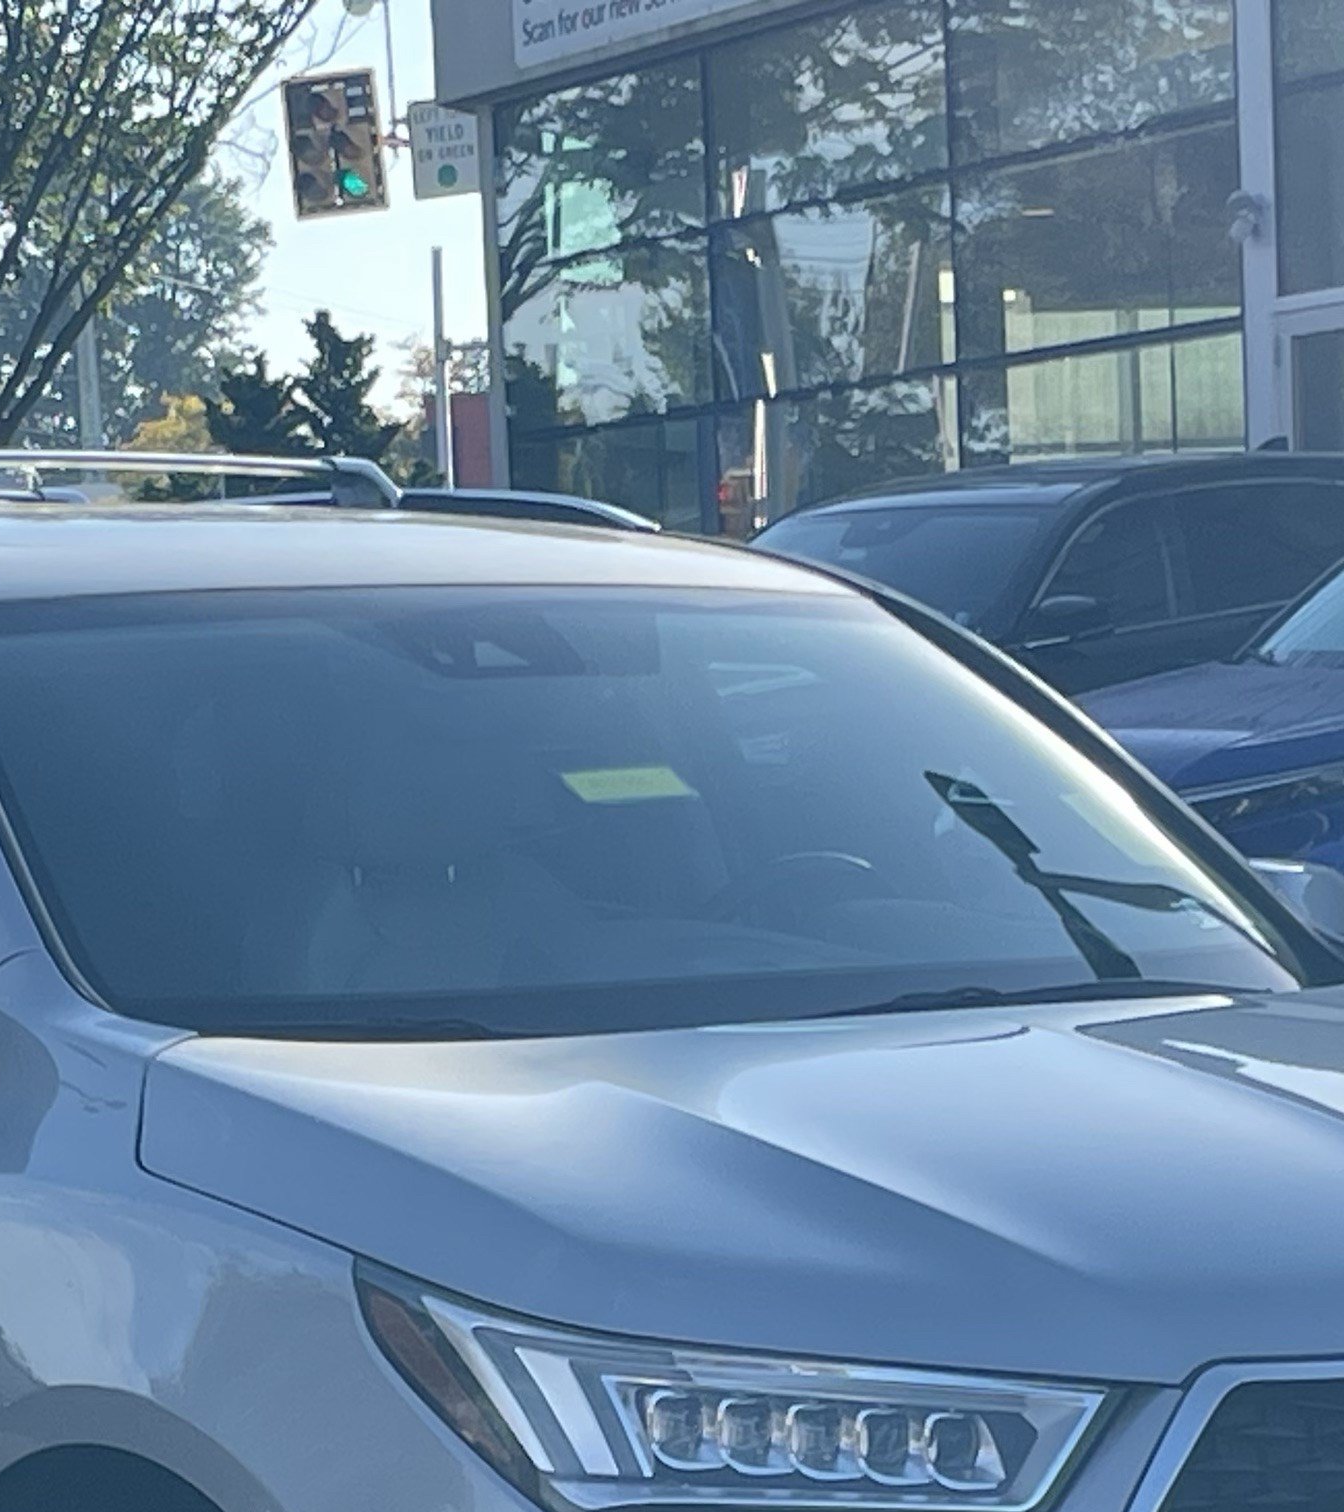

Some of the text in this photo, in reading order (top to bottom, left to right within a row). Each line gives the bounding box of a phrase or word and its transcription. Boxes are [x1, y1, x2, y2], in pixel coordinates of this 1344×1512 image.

[522, 17, 555, 47] Scan
[557, 8, 580, 36] for
[581, 3, 606, 30] our
[424, 123, 464, 143] YIELD
[438, 143, 475, 160] GREEN
